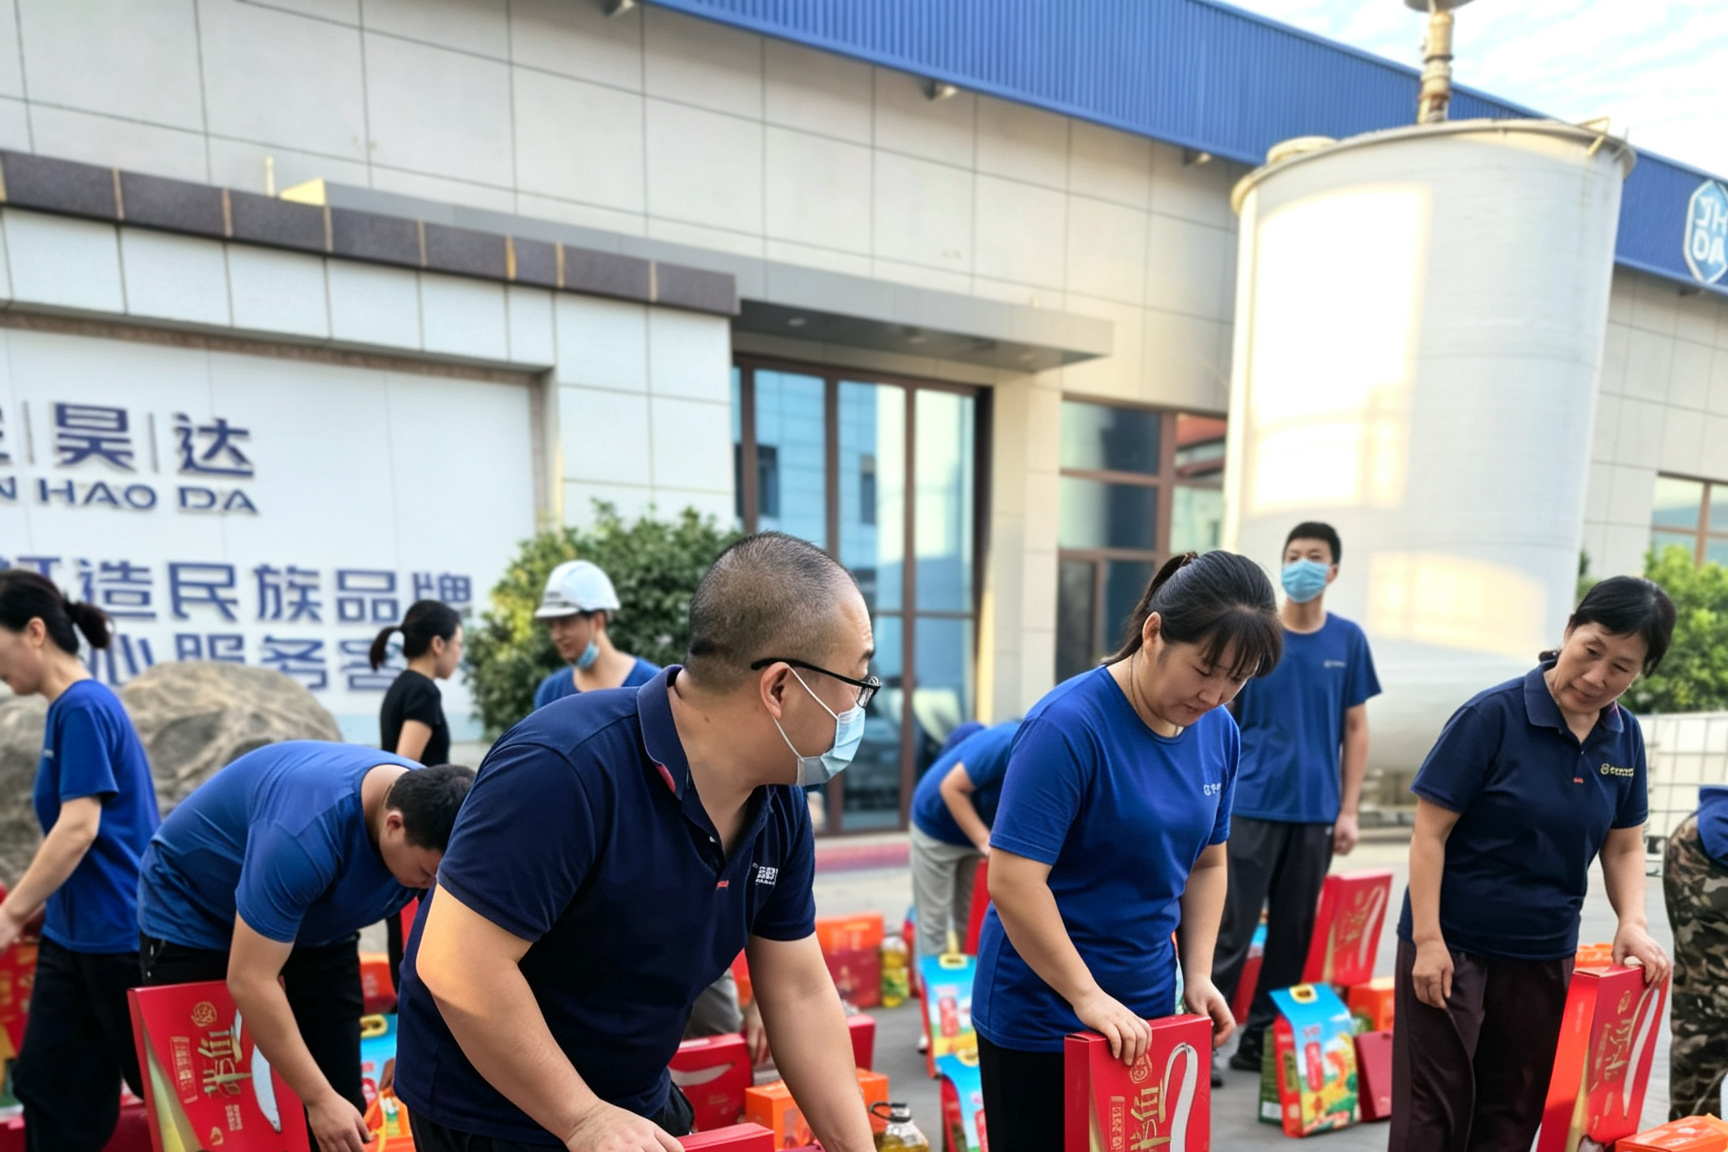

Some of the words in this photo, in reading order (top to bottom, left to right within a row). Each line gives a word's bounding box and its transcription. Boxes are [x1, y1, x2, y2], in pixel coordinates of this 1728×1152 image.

[0, 402, 255, 479] 昊达
[39, 478, 158, 511] HAO
[177, 486, 259, 515] DA
